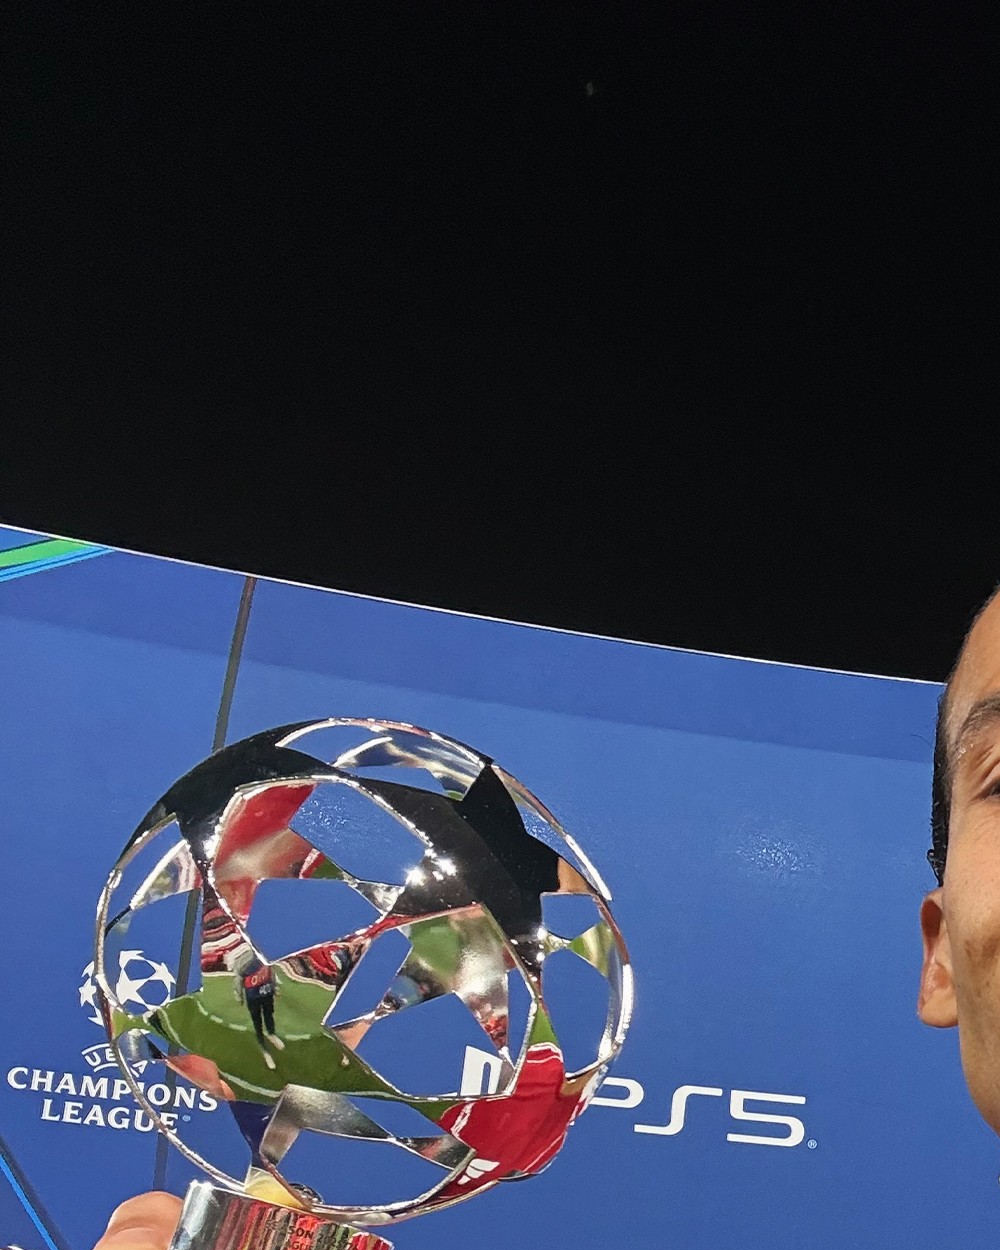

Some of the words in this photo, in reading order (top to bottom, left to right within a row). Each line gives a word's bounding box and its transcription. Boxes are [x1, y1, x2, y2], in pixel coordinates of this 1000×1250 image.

[85, 1049, 147, 1078] UEA
[41, 1098, 178, 1134] LEAGUE
[570, 1077, 806, 1147] PS5
